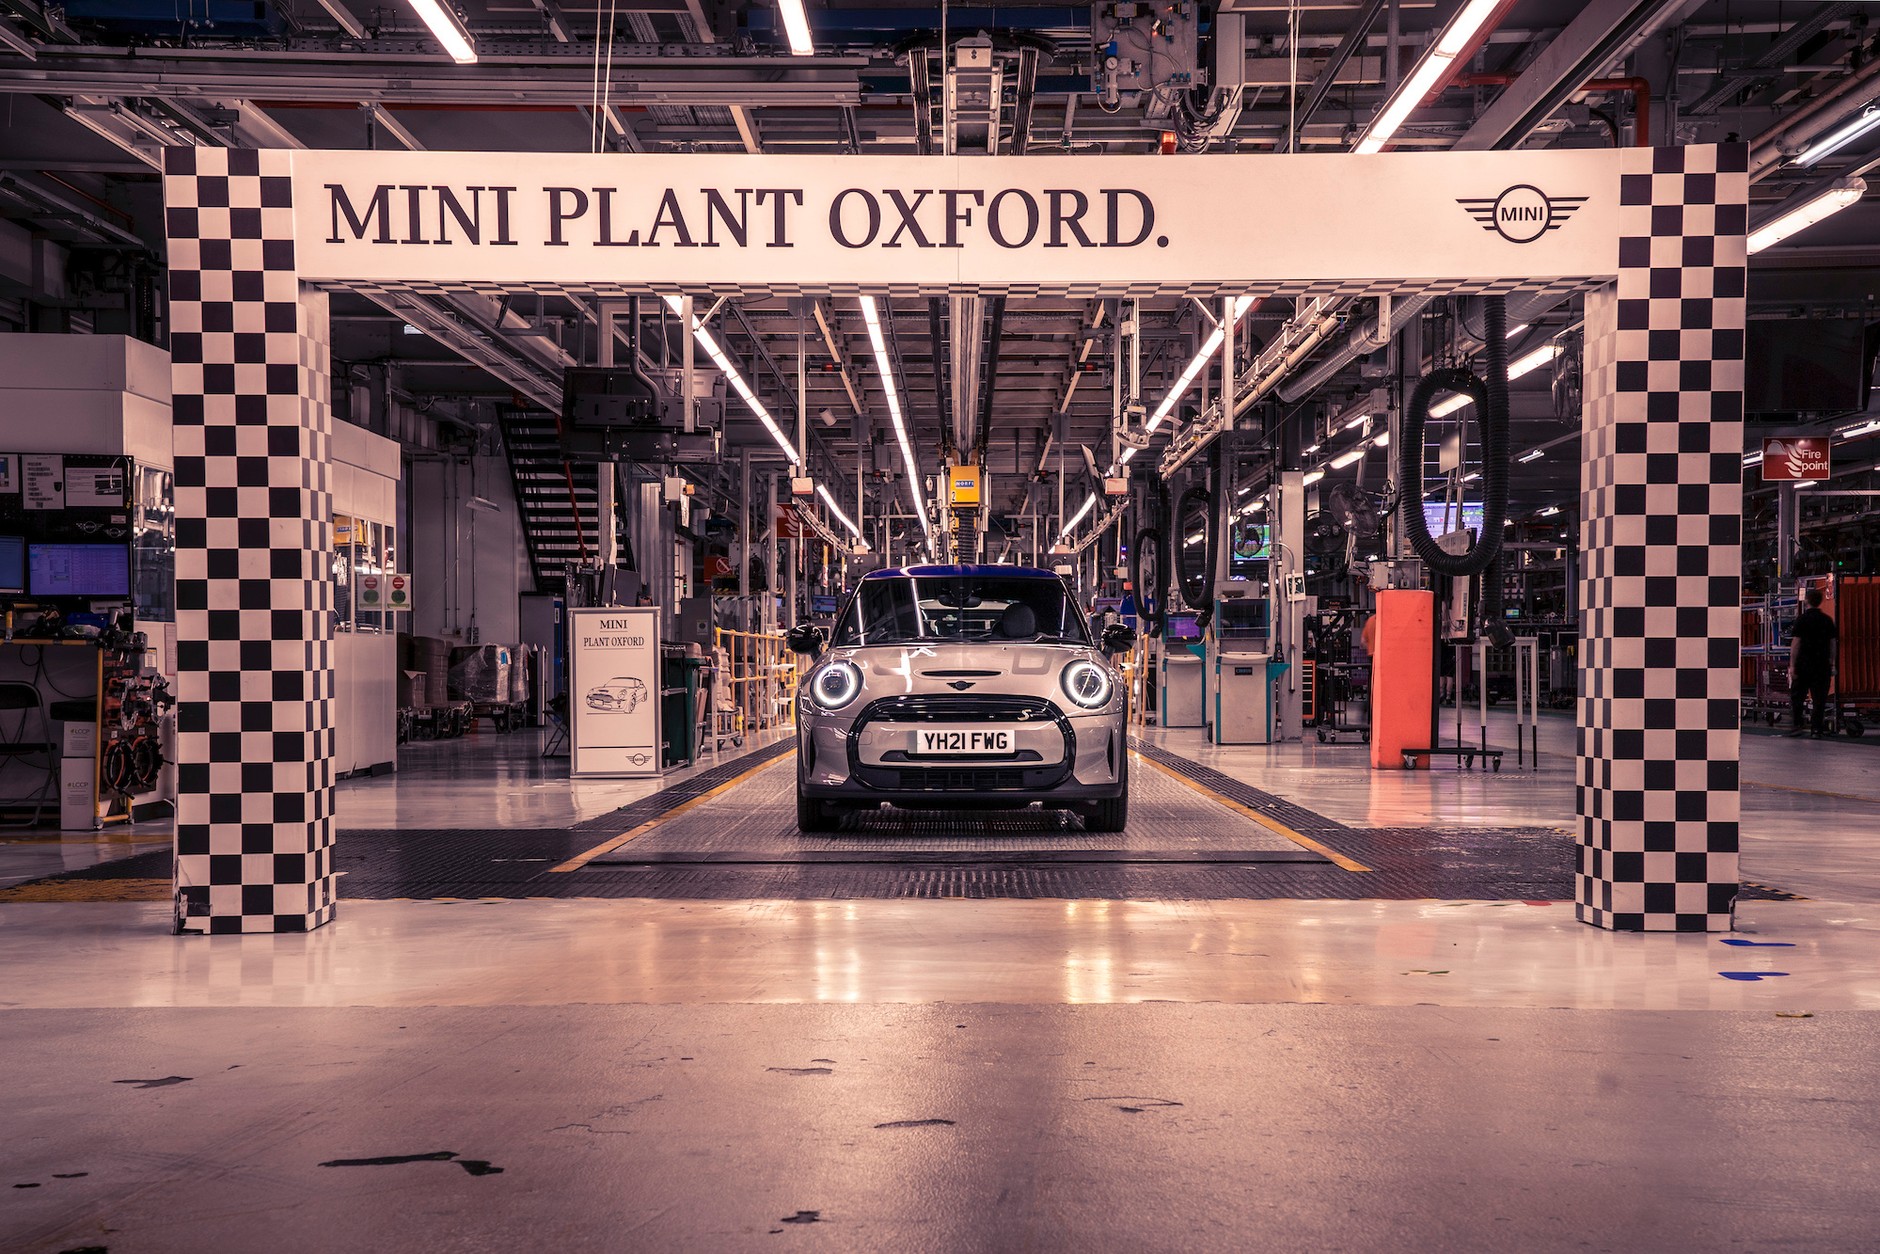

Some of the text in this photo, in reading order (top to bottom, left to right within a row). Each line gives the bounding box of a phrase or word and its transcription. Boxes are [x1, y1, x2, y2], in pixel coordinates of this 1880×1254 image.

[324, 184, 1168, 249] MINI PLANT OXFORD.
[1501, 206, 1543, 221] MINI
[1801, 449, 1822, 459] Fire
[1801, 461, 1828, 473] point
[600, 620, 628, 629] MINI
[584, 636, 645, 647] PLANT OXFORD
[1017, 708, 1032, 721] S
[924, 733, 1008, 750] YH21 FWG
